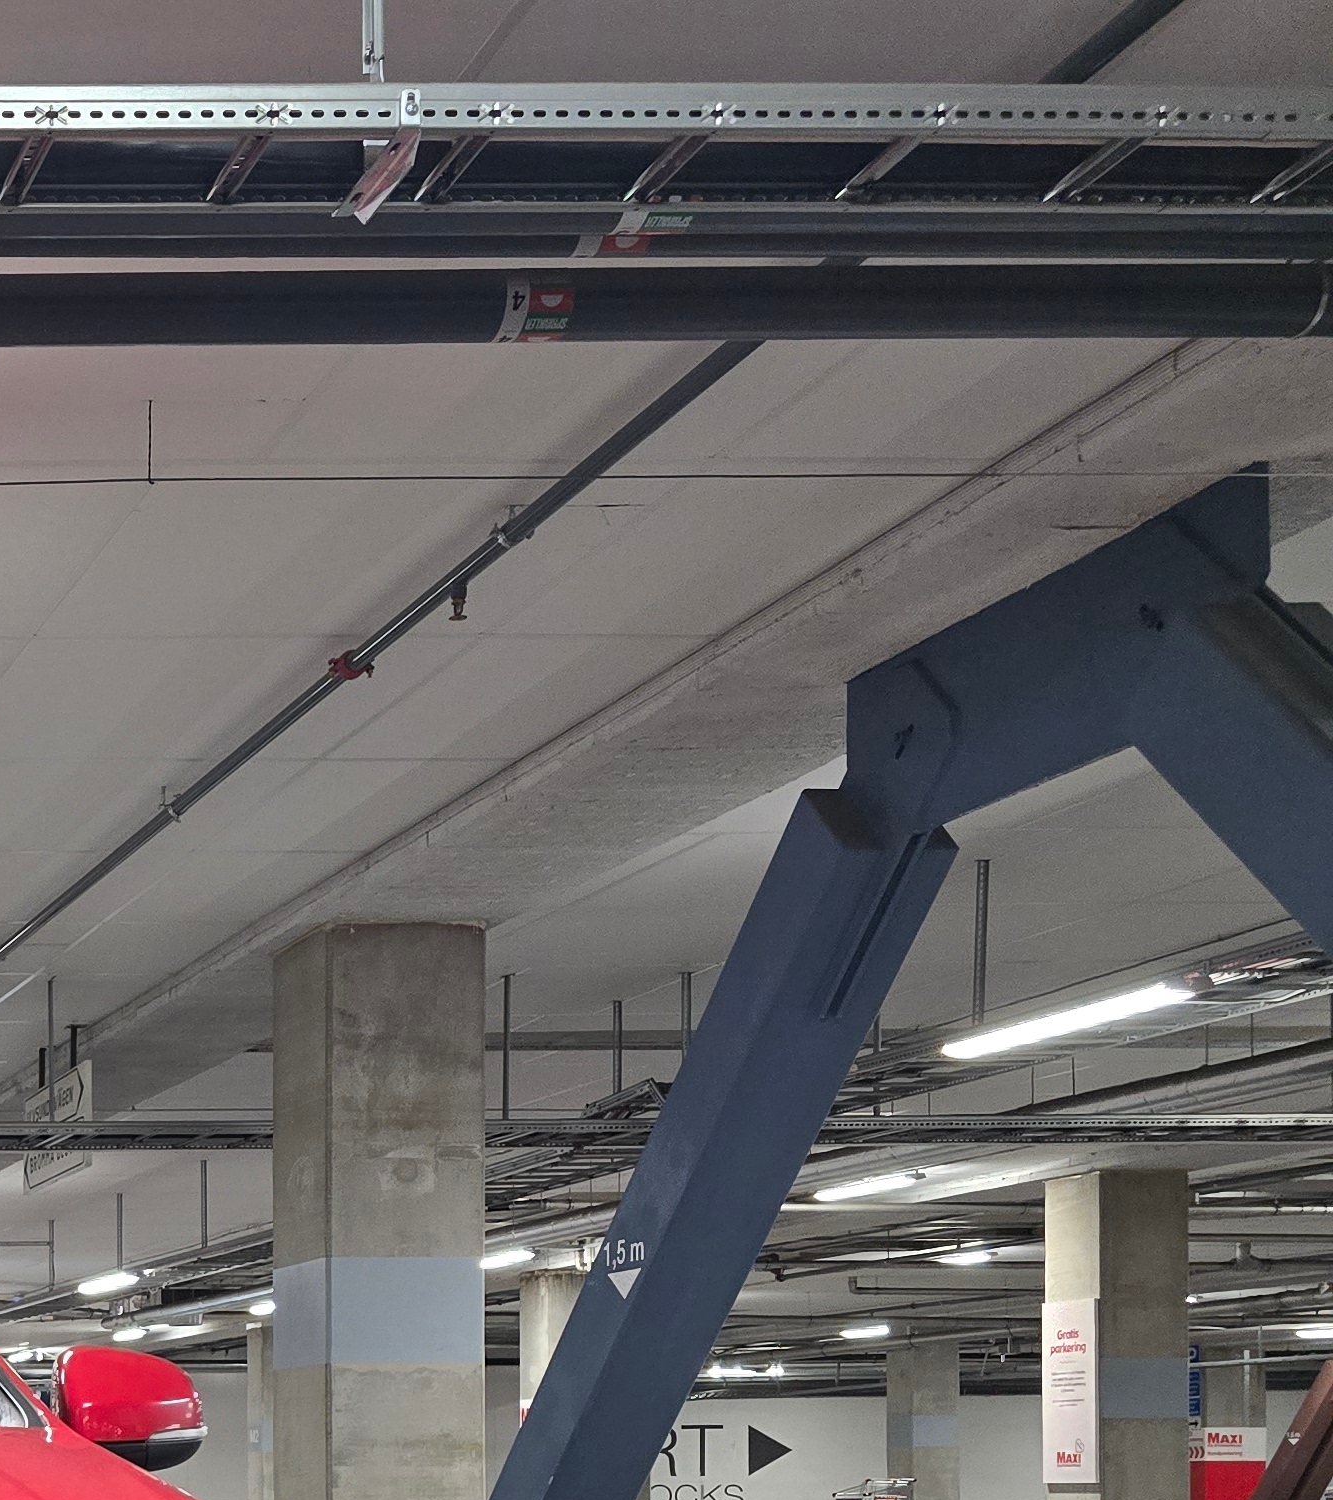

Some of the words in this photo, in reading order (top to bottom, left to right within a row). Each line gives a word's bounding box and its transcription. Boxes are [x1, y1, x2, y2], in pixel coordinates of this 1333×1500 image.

[603, 1239, 626, 1270] 1,5
[630, 1241, 645, 1262] m
[1057, 1328, 1079, 1340] Gratis
[1050, 1341, 1086, 1356] parkering
[1207, 1432, 1243, 1444] MAXI
[1056, 1451, 1081, 1464] MAXI
